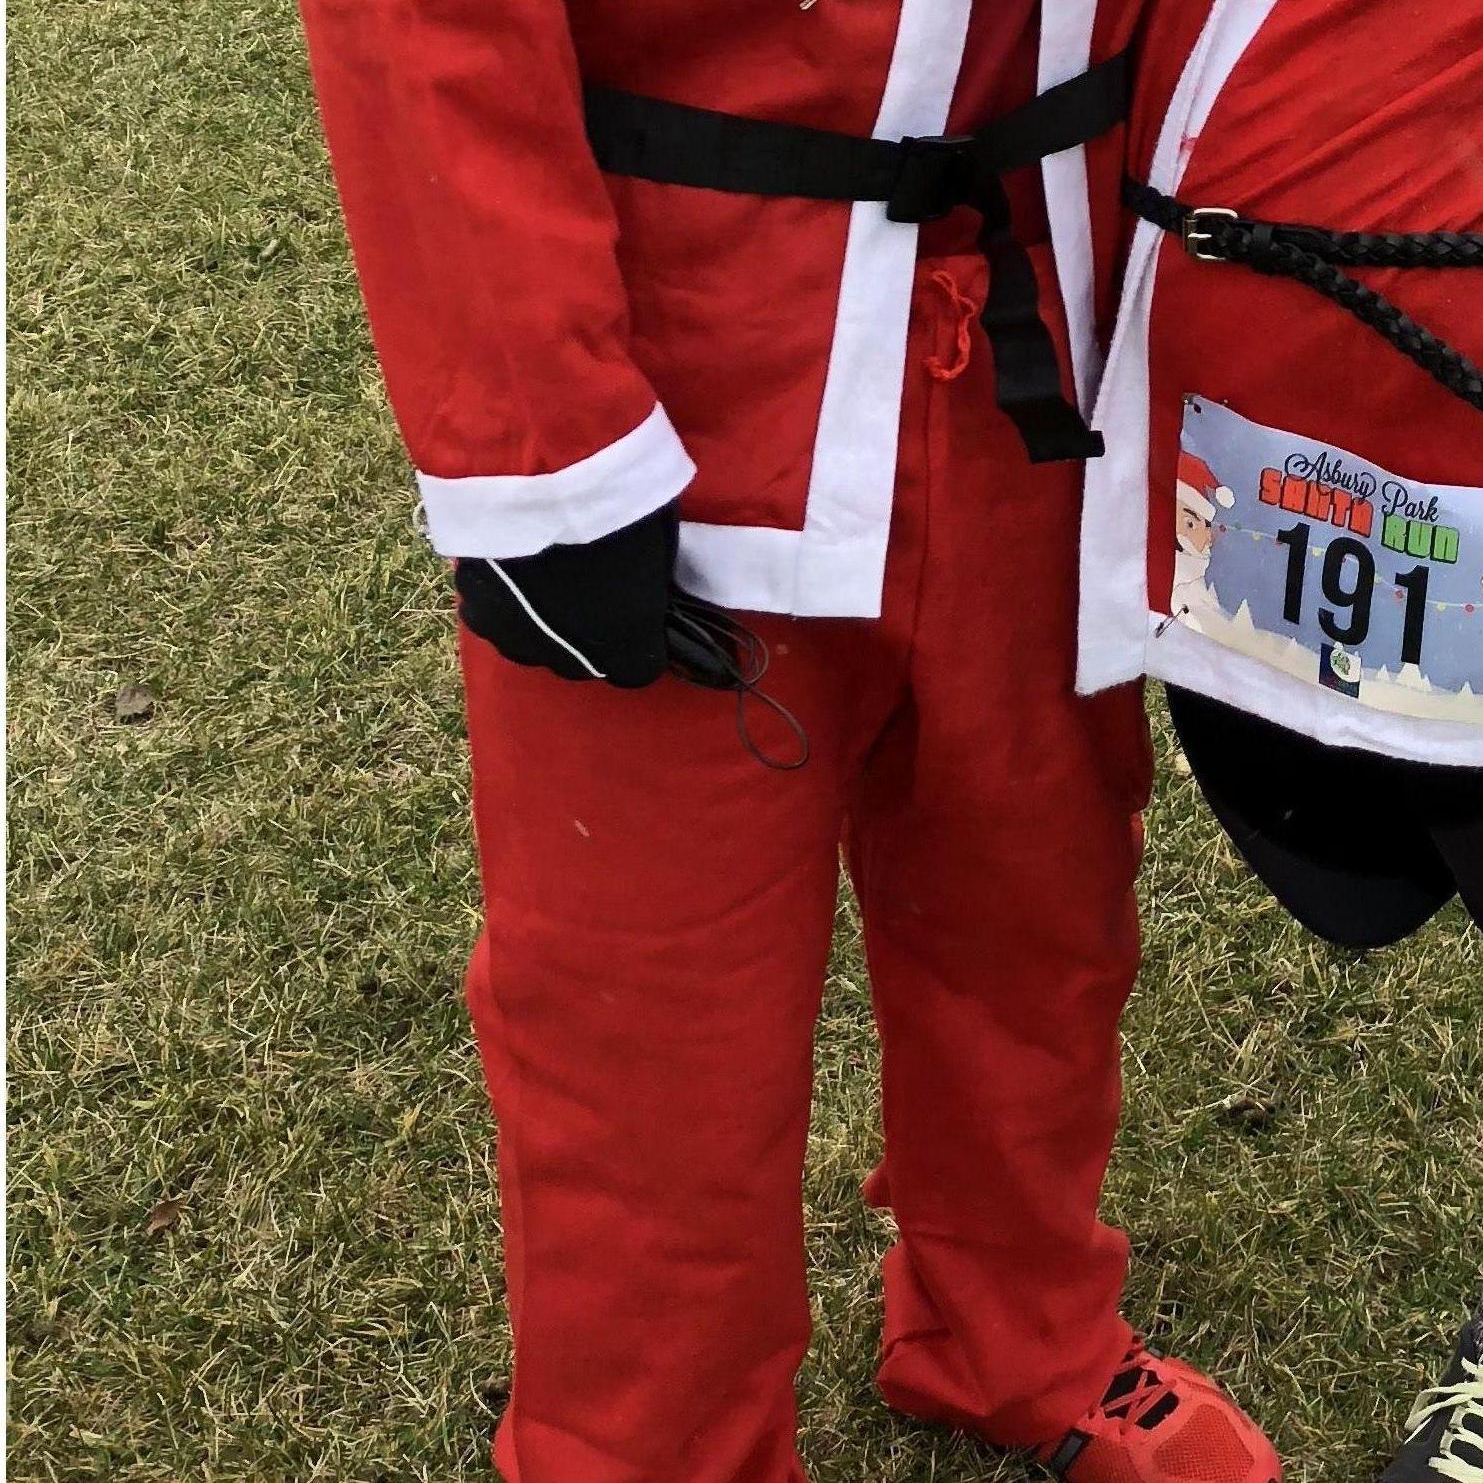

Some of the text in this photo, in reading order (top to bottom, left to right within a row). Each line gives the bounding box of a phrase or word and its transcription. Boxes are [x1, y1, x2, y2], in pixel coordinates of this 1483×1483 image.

[1258, 467, 1460, 564] SANTA RUN
[1284, 451, 1439, 522] Asbury Park
[1276, 522, 1430, 665] 191
